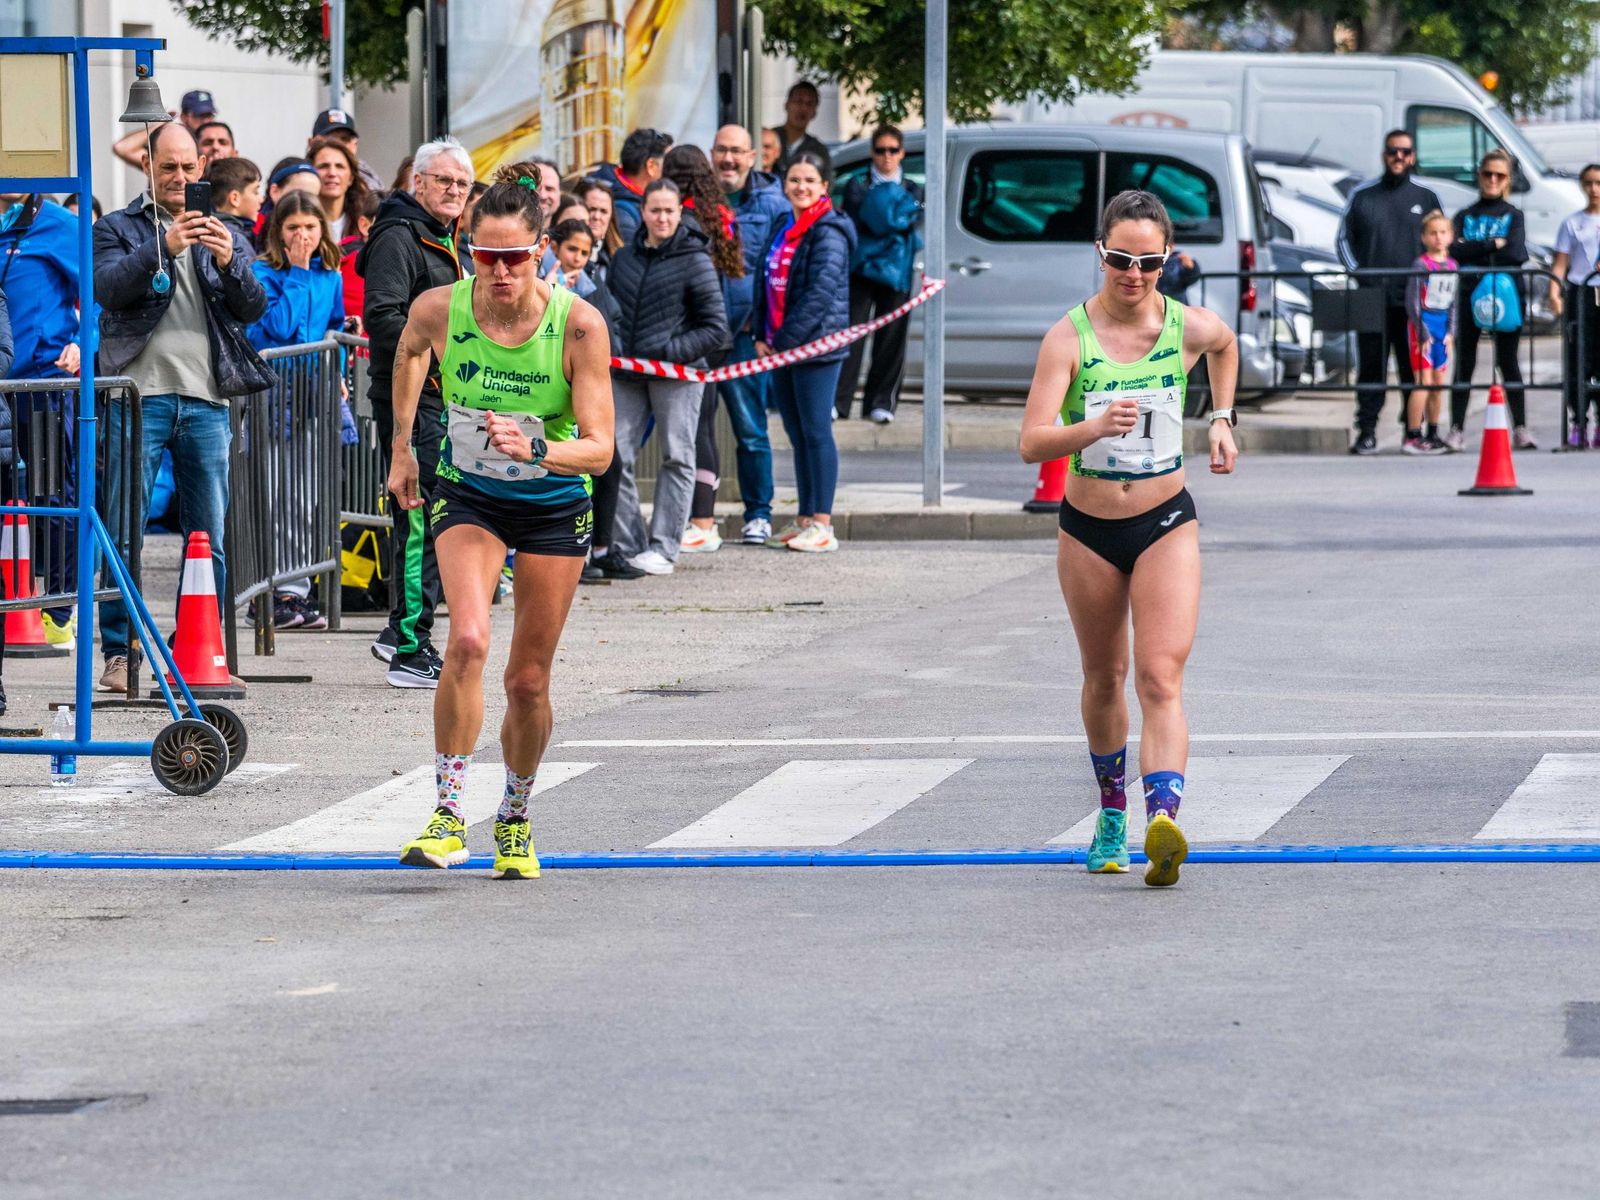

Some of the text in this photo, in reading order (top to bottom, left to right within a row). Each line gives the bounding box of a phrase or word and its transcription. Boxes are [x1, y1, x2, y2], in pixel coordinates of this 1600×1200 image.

[484, 366, 550, 384] Fundación
[1121, 374, 1157, 386] Fundación
[482, 378, 530, 396] Unicaja
[1121, 383, 1148, 391] Unicaja
[480, 393, 502, 403] Jaén
